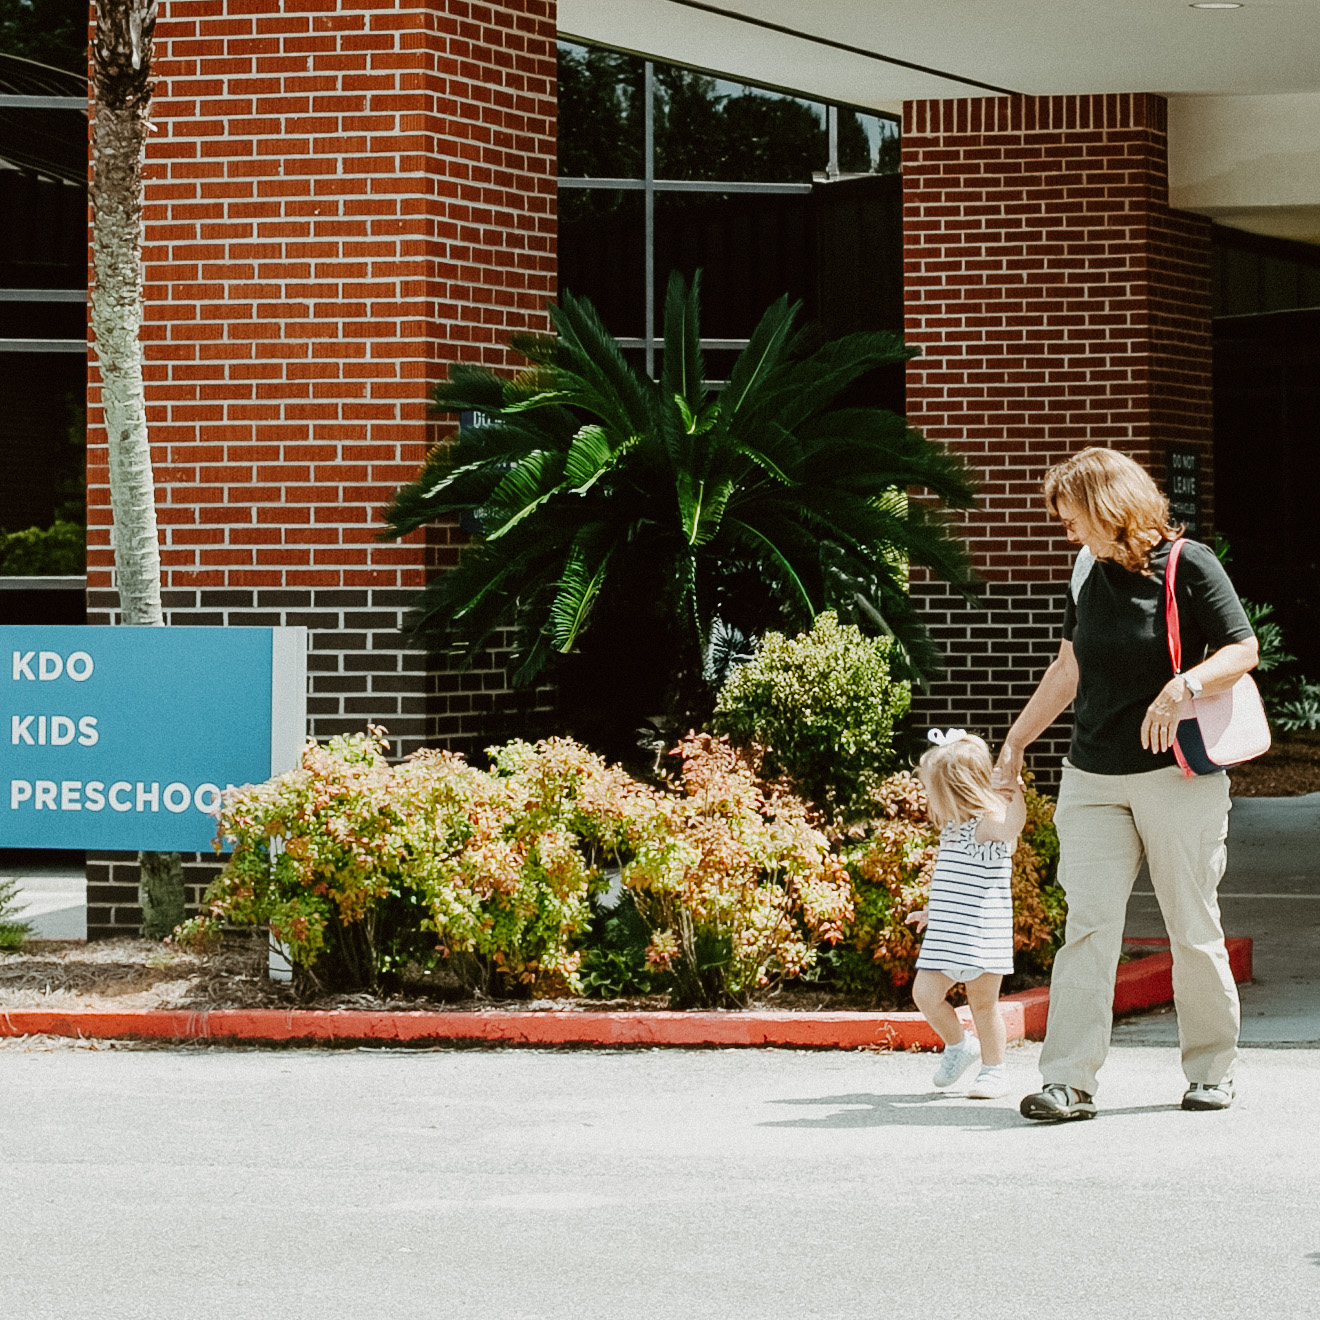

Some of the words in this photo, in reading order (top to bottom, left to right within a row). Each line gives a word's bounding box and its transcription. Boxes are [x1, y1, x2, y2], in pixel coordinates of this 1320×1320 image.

[1172, 453, 1181, 468] DO
[1183, 455, 1195, 469] NOT
[1173, 476, 1196, 495] LEAVE
[12, 651, 94, 681] KDO
[11, 715, 99, 746] KIDS
[11, 780, 235, 813] PRESCHOO
